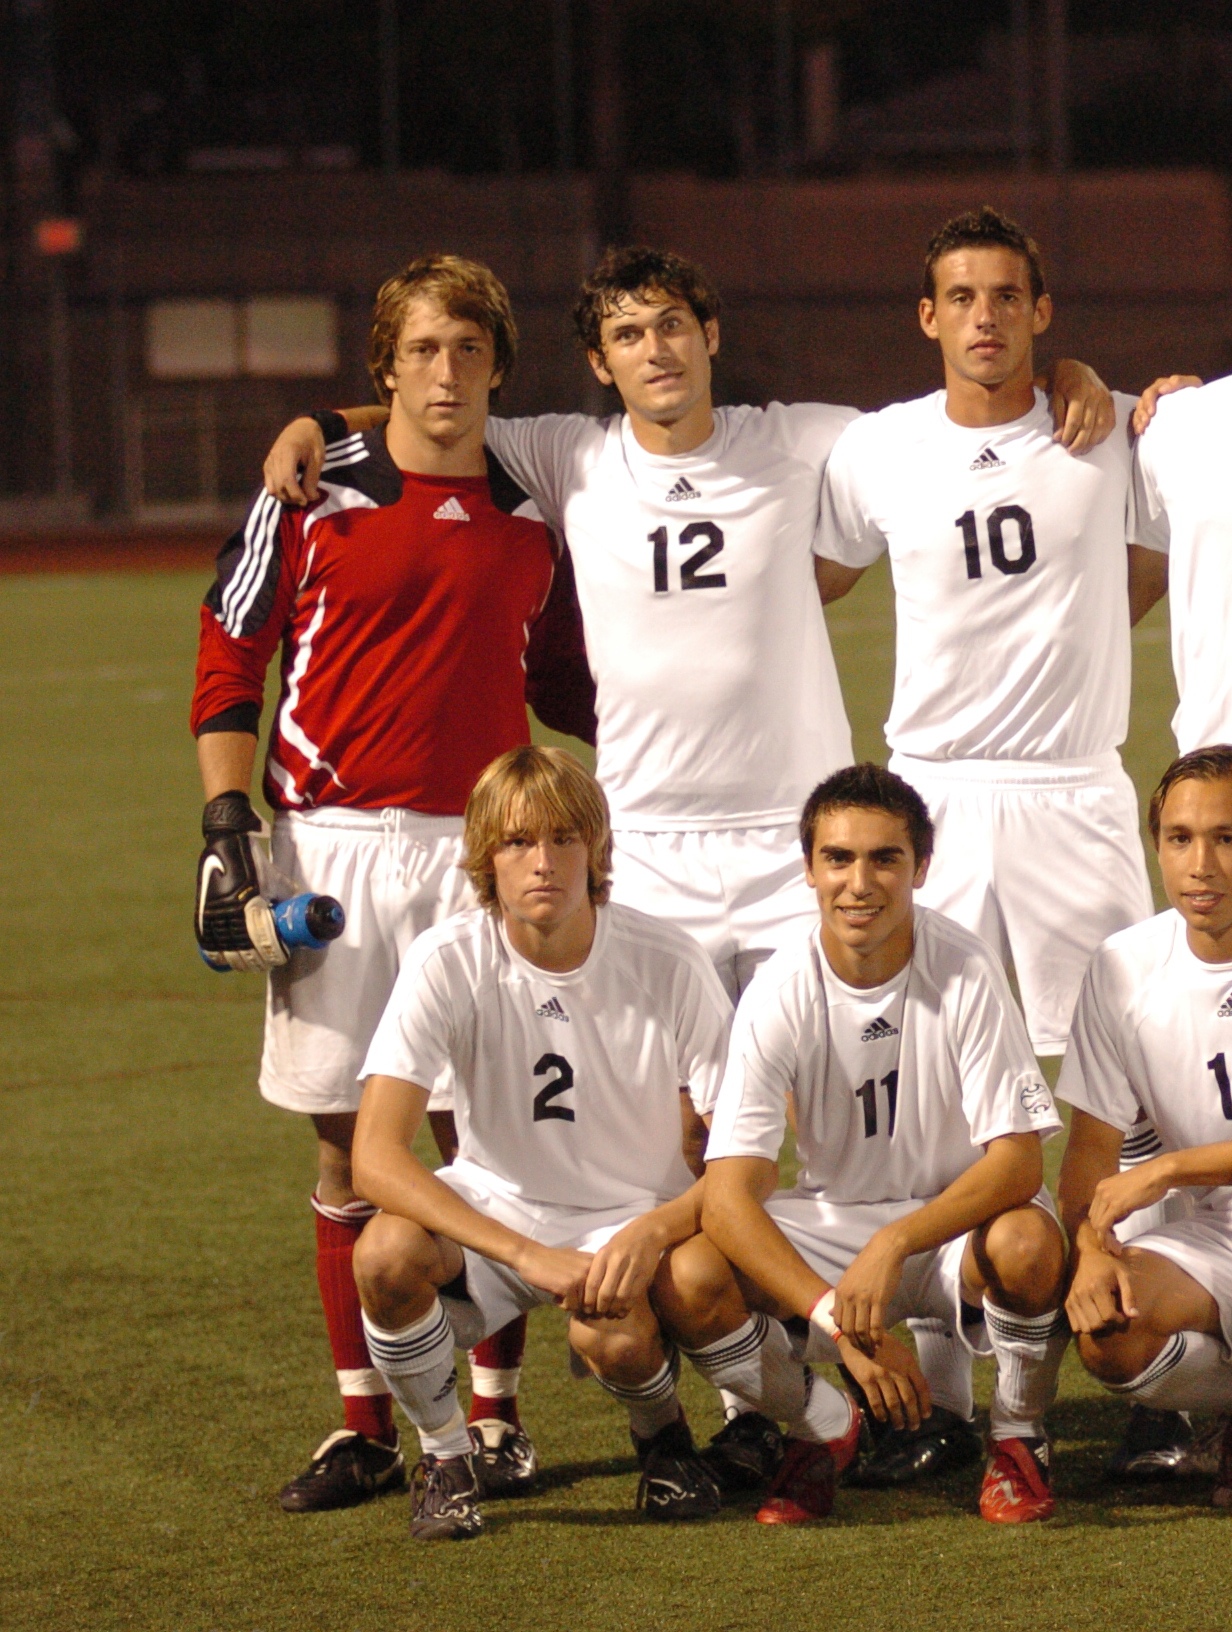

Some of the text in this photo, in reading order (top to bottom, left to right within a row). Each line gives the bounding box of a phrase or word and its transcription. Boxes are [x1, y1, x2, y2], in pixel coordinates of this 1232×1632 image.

[969, 461, 1006, 472] adidas
[665, 490, 701, 502] adidas
[649, 521, 728, 593] 12
[955, 505, 1037, 580] 10
[536, 1008, 570, 1023] adidas
[861, 1028, 899, 1042] adidas
[533, 1052, 576, 1123] 2
[855, 1070, 898, 1139] 11
